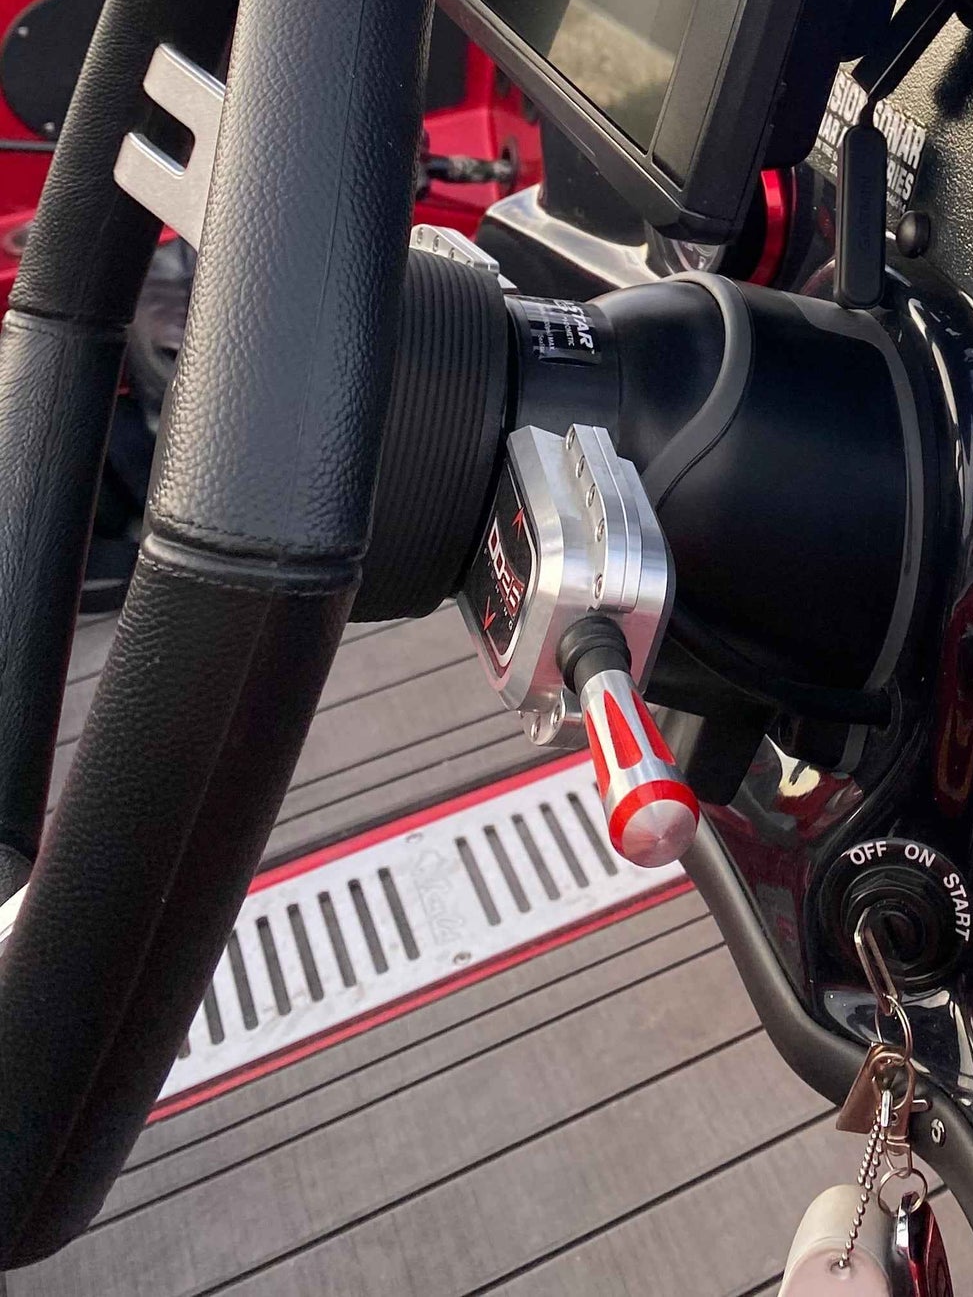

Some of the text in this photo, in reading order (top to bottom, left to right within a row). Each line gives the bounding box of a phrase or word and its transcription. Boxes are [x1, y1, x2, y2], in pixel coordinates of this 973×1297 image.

[849, 840, 888, 866] OFF
[904, 844, 937, 868] ON
[943, 872, 972, 942] START
